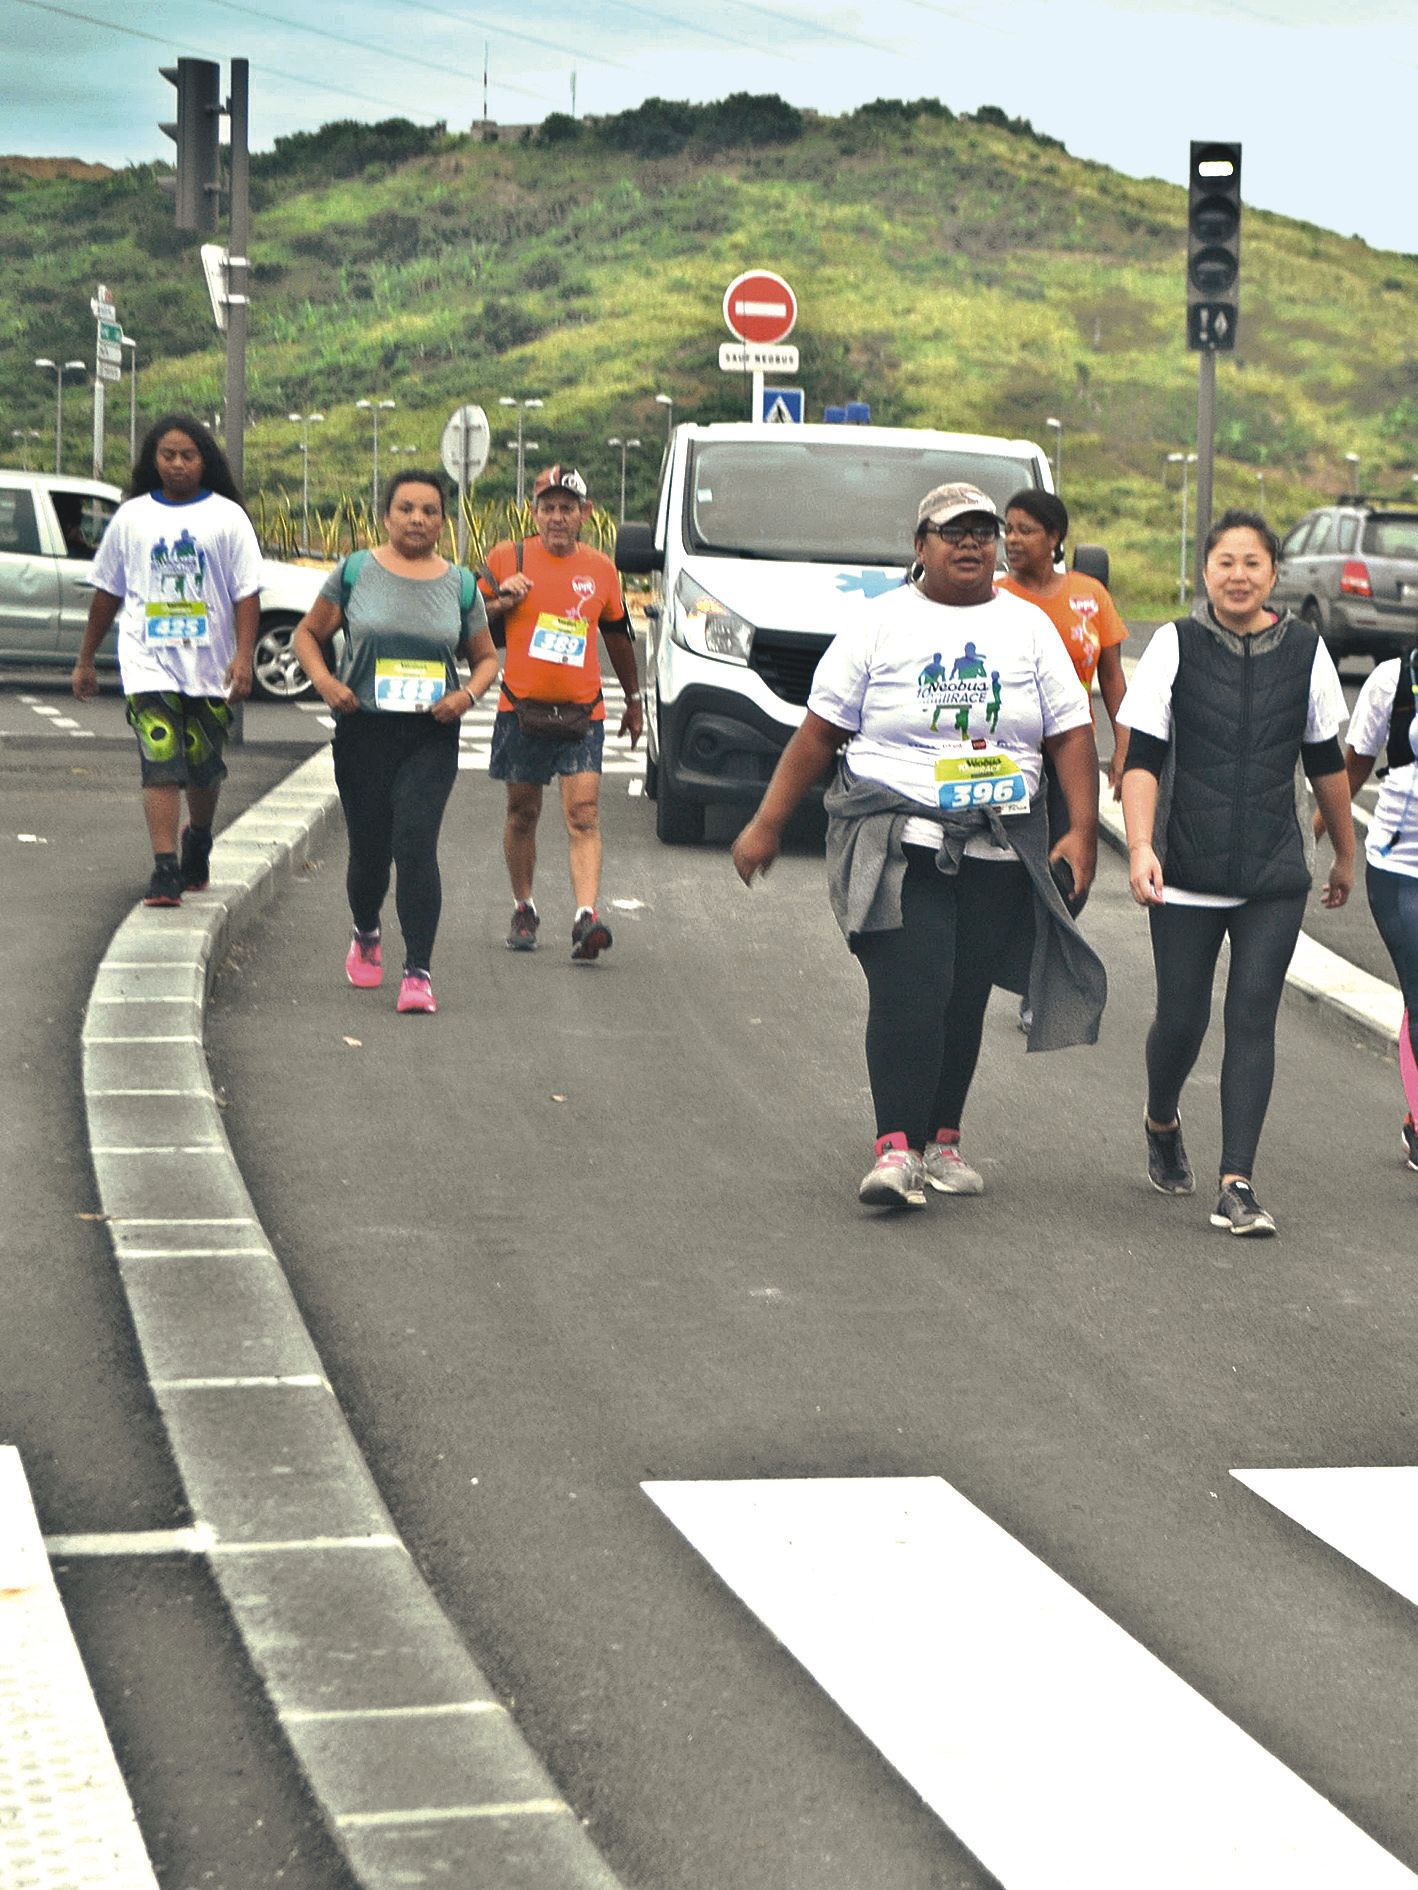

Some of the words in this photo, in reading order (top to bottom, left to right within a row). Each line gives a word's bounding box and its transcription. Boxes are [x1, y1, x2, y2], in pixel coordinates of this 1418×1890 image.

[754, 354, 794, 364] NEOBUS
[541, 633, 579, 655] 389
[952, 780, 1014, 807] 396
